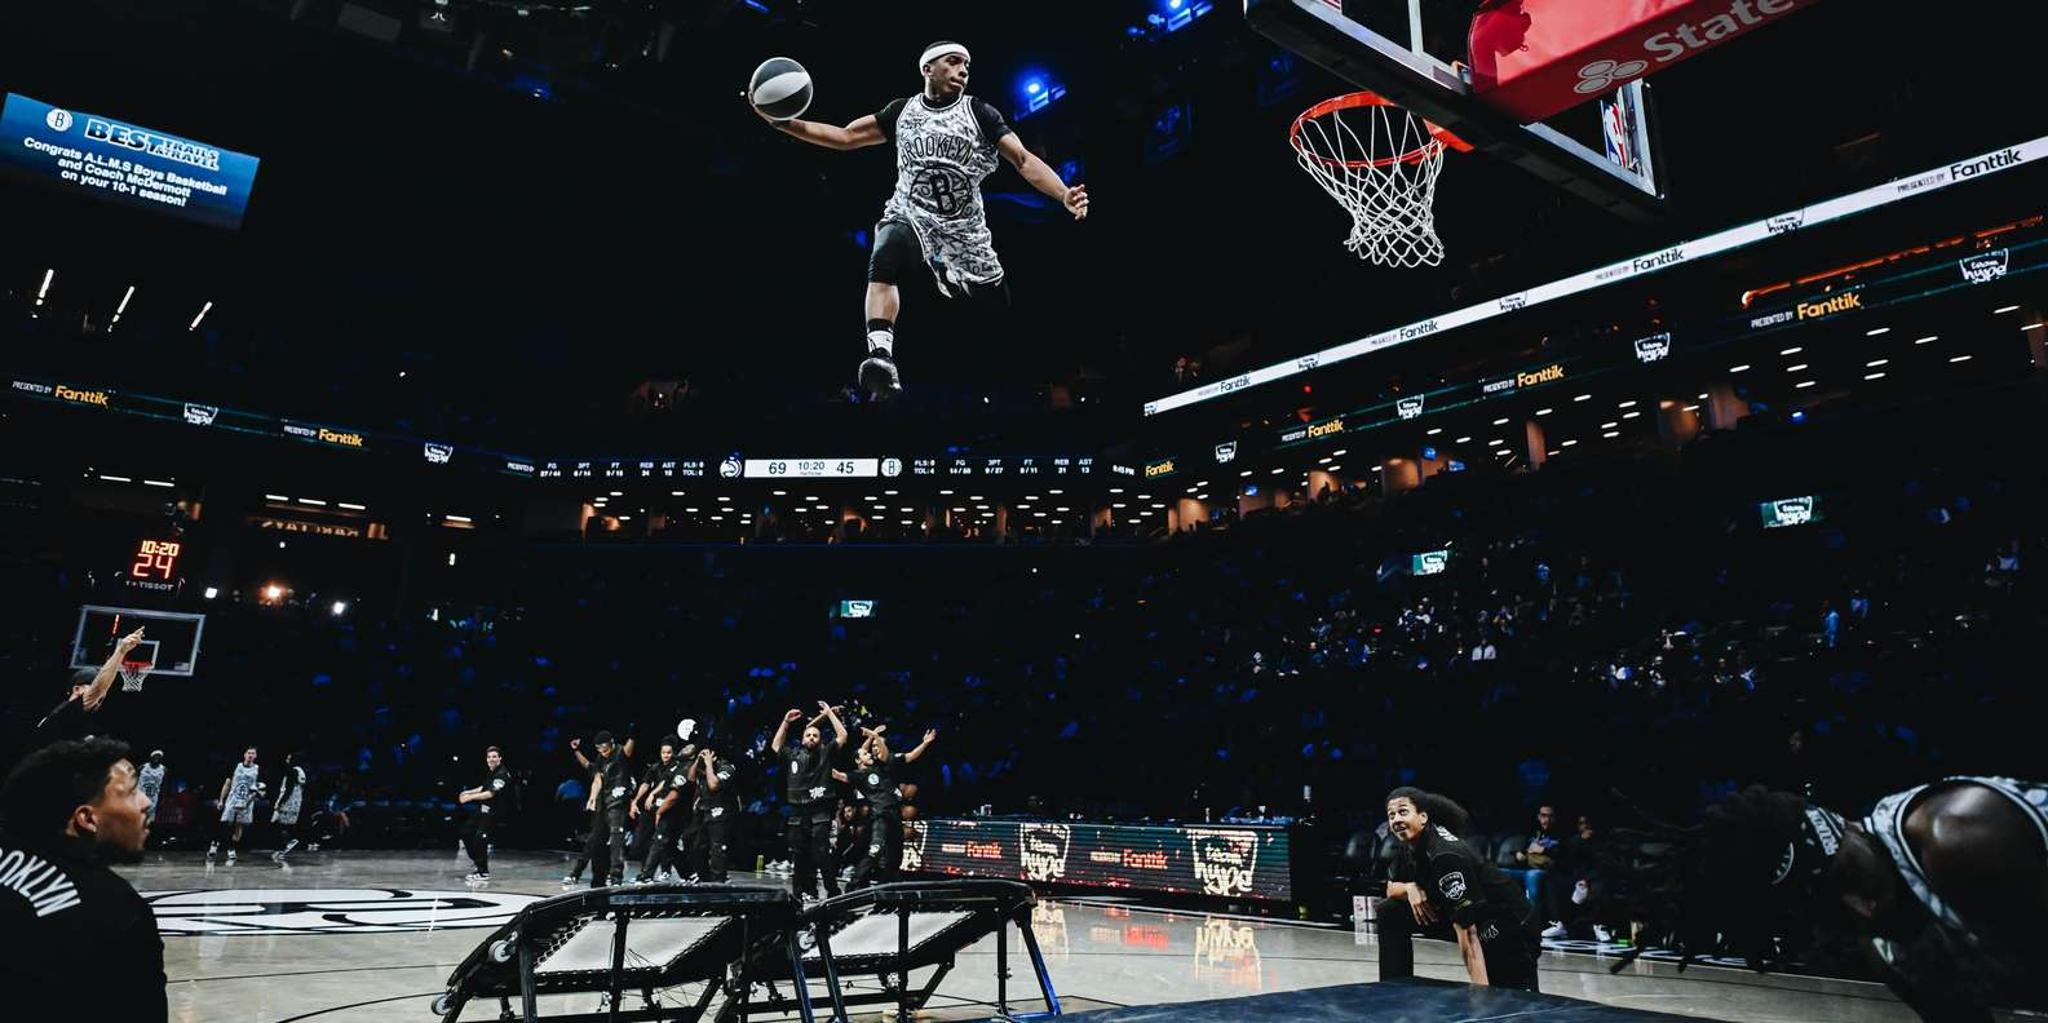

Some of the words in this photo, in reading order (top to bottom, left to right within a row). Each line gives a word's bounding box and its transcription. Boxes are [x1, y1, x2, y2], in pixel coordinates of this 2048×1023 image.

[84, 118, 164, 154] BEST
[902, 135, 974, 167] BROOKLYN
[24, 137, 82, 160] Congrats
[133, 164, 164, 180] Boys
[166, 172, 228, 196] Basketball
[1950, 149, 2022, 180] Fanttik
[58, 158, 83, 171] and
[84, 163, 124, 181] Coach
[126, 172, 191, 197] McDermott
[61, 170, 78, 181] on
[79, 174, 110, 188] your
[112, 180, 136, 195] 10-1
[139, 188, 187, 207] season!
[1633, 248, 1684, 273] Fanttik
[1797, 292, 1860, 320] Fanttik
[1399, 320, 1438, 341] Fanttik
[1517, 364, 1564, 388] Fanttik
[55, 384, 108, 406] Fanttik
[318, 428, 363, 447] Fanttik
[1308, 418, 1344, 439] Fanttik
[769, 462, 786, 475] 69
[798, 461, 825, 471] 10:20
[837, 461, 854, 475] 45
[1145, 460, 1174, 478] Fanttik
[141, 540, 180, 557] 10:20
[132, 553, 173, 579] 24
[140, 581, 175, 591] TISSOT
[1020, 851, 1065, 882] hype
[1123, 849, 1168, 870] Fanttik
[0, 847, 81, 917] OKLYN
[1194, 860, 1254, 897] hype
